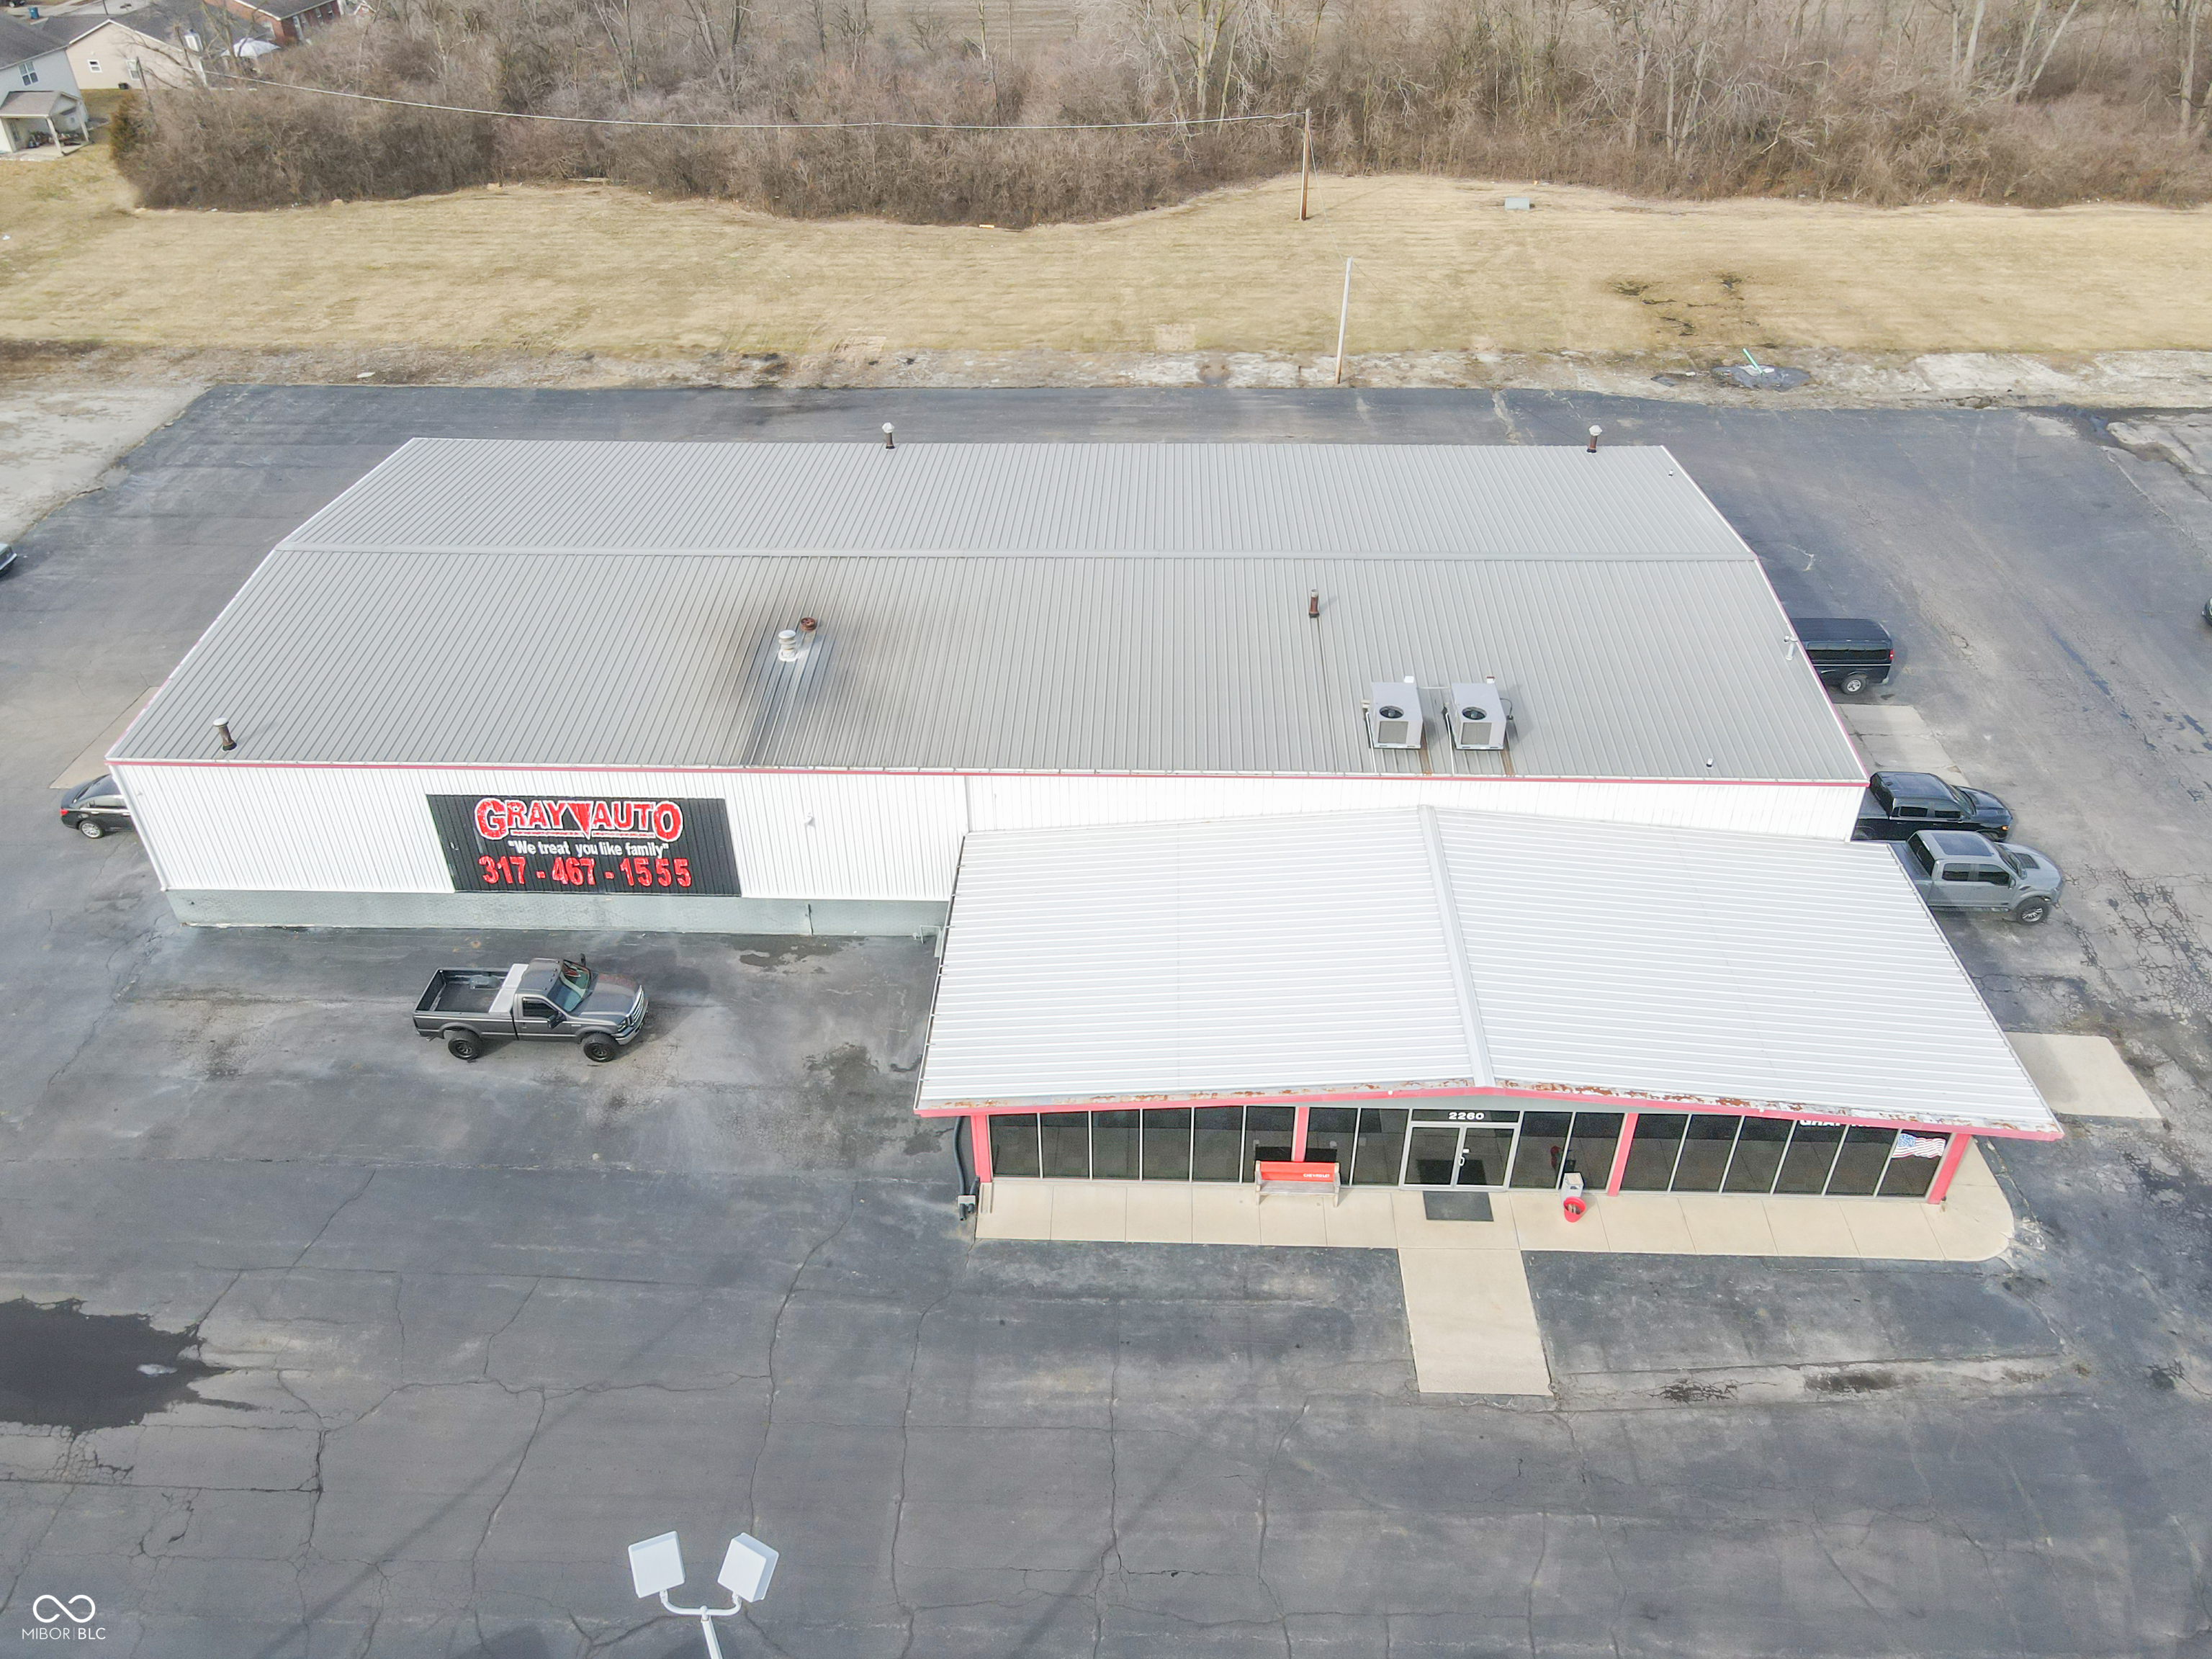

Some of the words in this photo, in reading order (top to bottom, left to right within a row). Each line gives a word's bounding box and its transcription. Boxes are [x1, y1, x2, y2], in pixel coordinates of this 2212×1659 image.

[475, 798, 569, 840] GRAY
[590, 801, 683, 842] AUTO
[538, 841, 571, 855] treat
[575, 843, 598, 858] you
[598, 842, 623, 855] like
[478, 855, 526, 884] 317
[552, 856, 595, 886] 467
[619, 857, 691, 887] 1555
[1448, 1112, 1485, 1120] 2260
